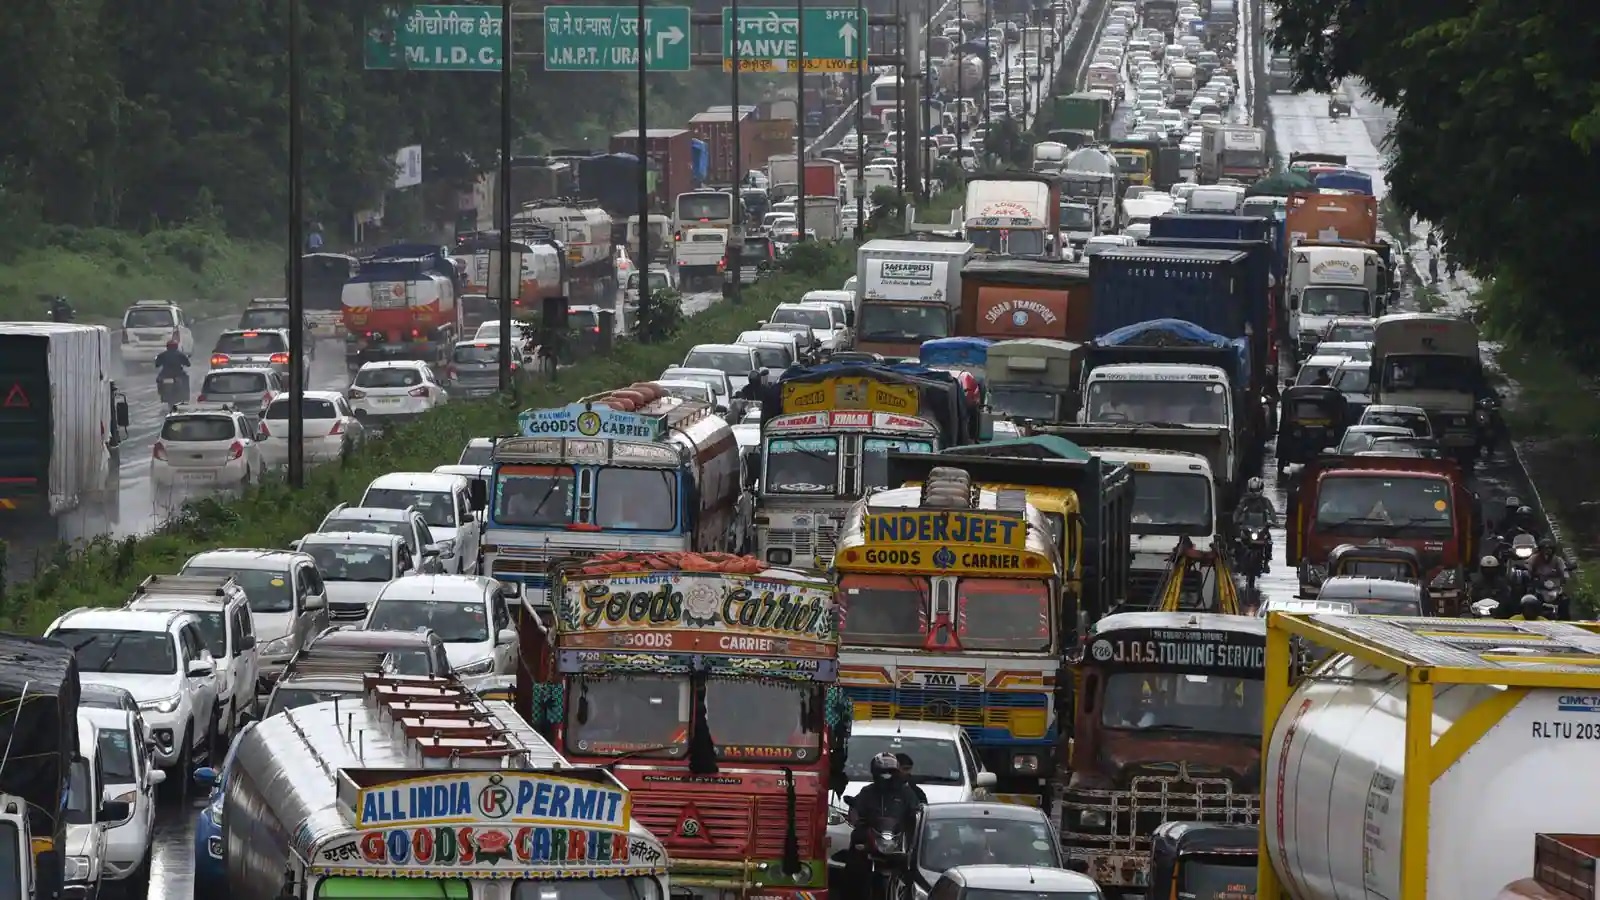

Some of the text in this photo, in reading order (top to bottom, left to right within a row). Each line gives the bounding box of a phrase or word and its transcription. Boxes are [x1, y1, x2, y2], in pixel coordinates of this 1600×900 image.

[550, 47, 600, 65] J.N.P.T.
[730, 39, 809, 57] PANVE
[1012, 299, 1057, 326] TRANSPORT
[529, 419, 650, 437] GOODS CARRIER
[865, 549, 1020, 569] GOODS CARRIER
[744, 579, 790, 592] PERMIT
[582, 583, 824, 632] Goods Carrier
[1159, 641, 1216, 666] TOWING
[923, 674, 957, 685] TATA
[1558, 695, 1590, 705] CIMC
[1532, 720, 1572, 739] RLTU
[723, 745, 742, 758] AL
[361, 789, 407, 824] ALL
[409, 781, 472, 818] INDIA
[515, 779, 622, 822] PERMIT
[359, 826, 630, 866] GOODS CARRIER
